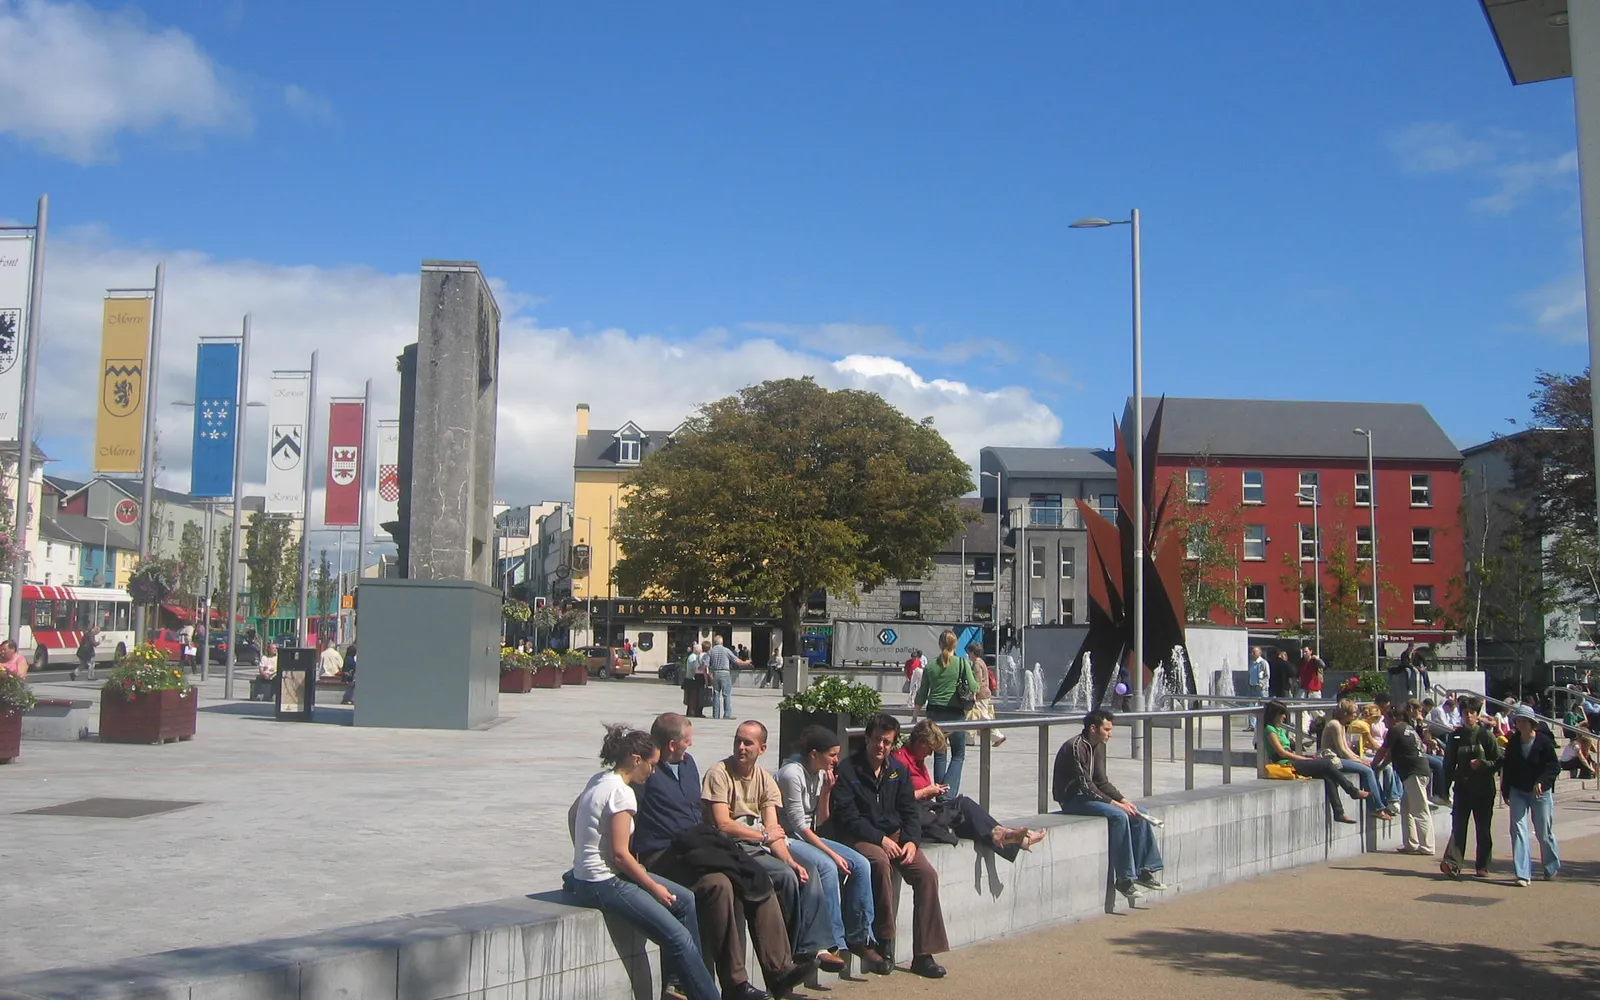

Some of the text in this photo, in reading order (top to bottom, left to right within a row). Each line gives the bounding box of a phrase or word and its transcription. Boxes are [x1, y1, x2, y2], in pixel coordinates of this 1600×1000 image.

[108, 312, 145, 325] Morris
[99, 445, 137, 457] Morris
[618, 604, 737, 616] RICARDSONS
